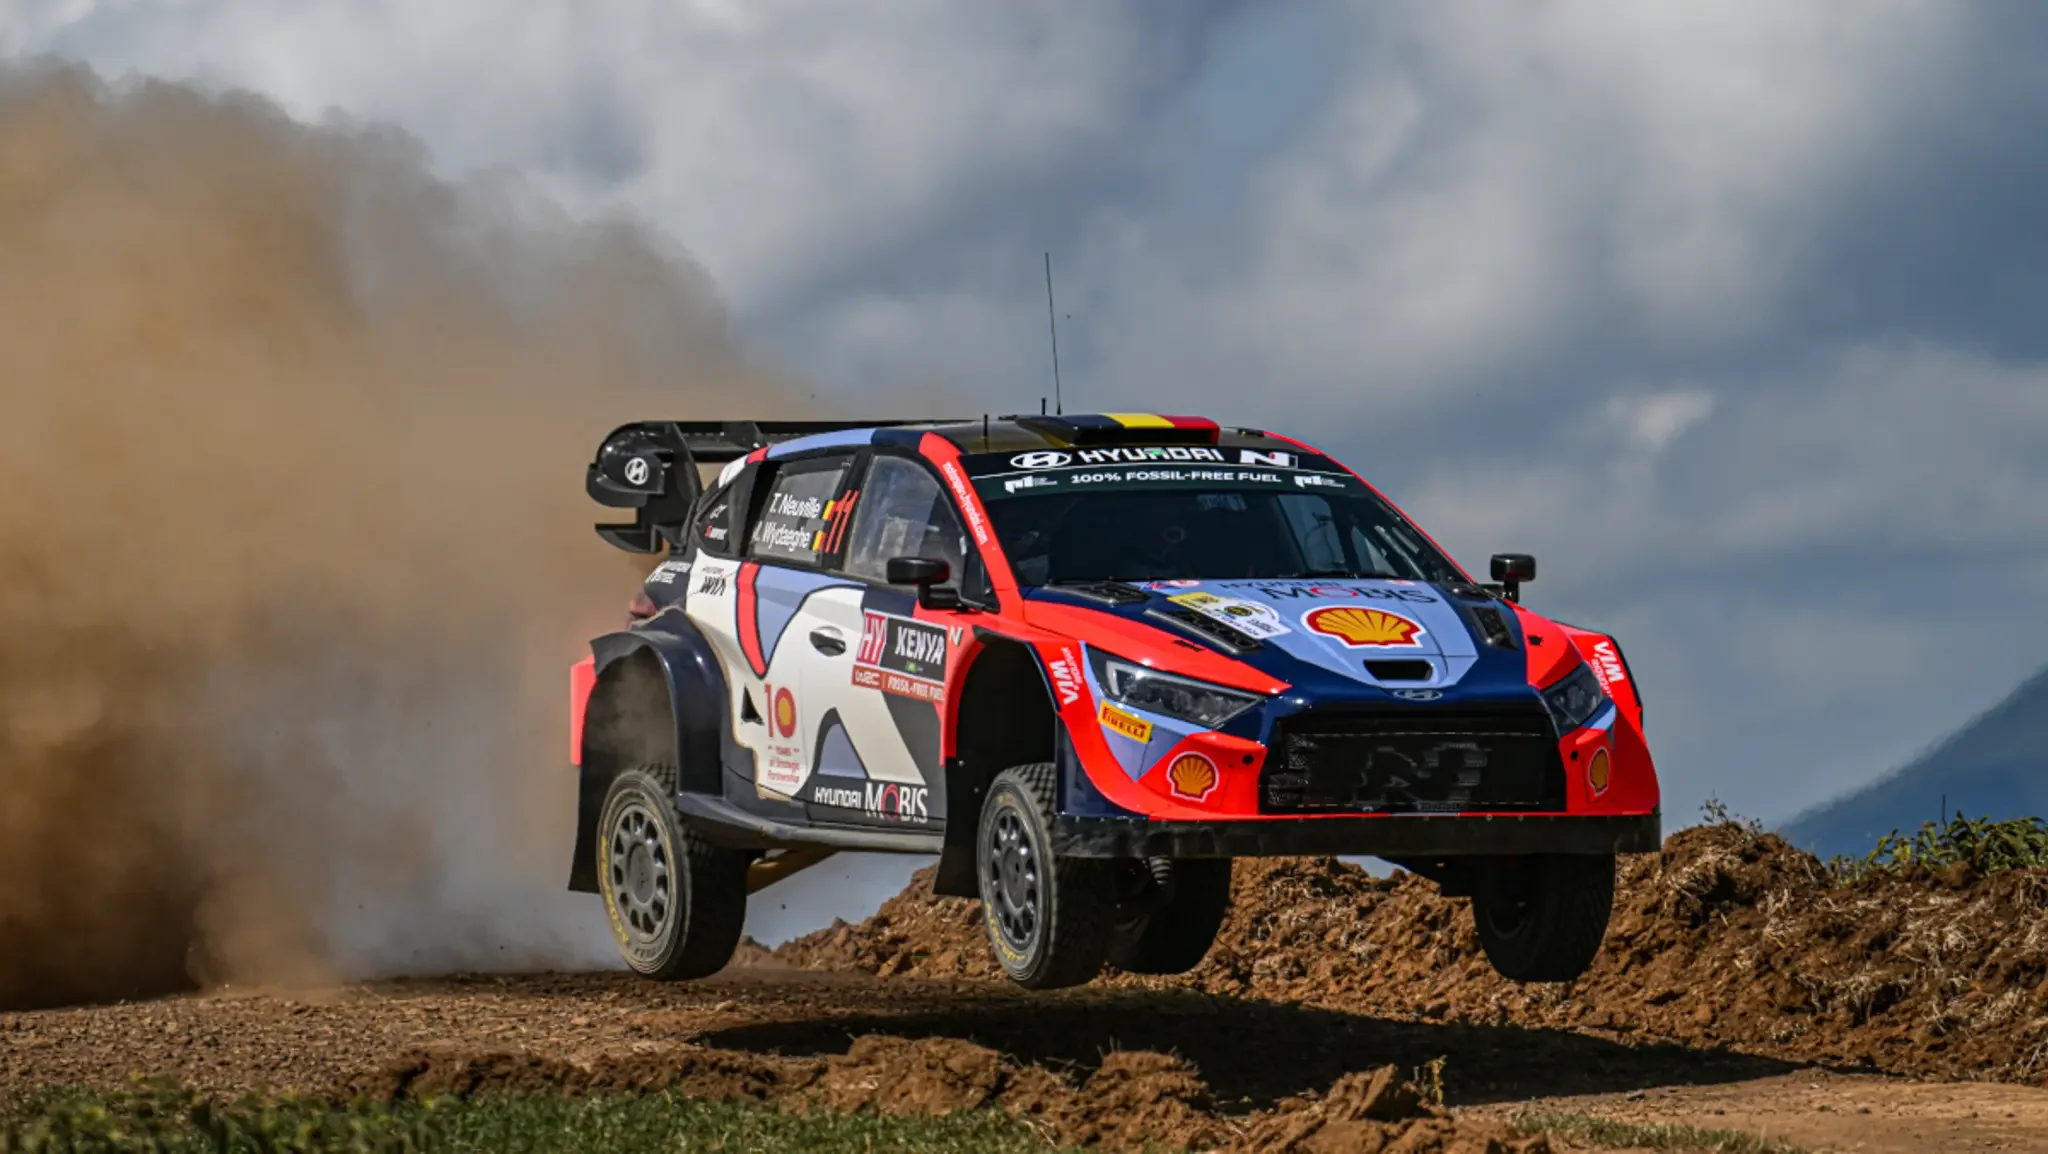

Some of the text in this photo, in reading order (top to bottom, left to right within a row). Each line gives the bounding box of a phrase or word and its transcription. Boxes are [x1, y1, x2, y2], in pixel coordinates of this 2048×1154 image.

[1077, 447, 1225, 464] HYUNDAI
[1071, 472, 1122, 484] 100%
[1126, 470, 1235, 481] FOSSIL-FREE
[1238, 472, 1282, 482] FUEL
[778, 494, 821, 519] Neuville
[762, 521, 811, 553] Wydaeghe
[1259, 585, 1439, 604] MOBIS
[894, 625, 946, 666] KENYA
[1102, 706, 1148, 739] PIRELLI
[814, 782, 929, 824] HYUNDAI MOBIS
